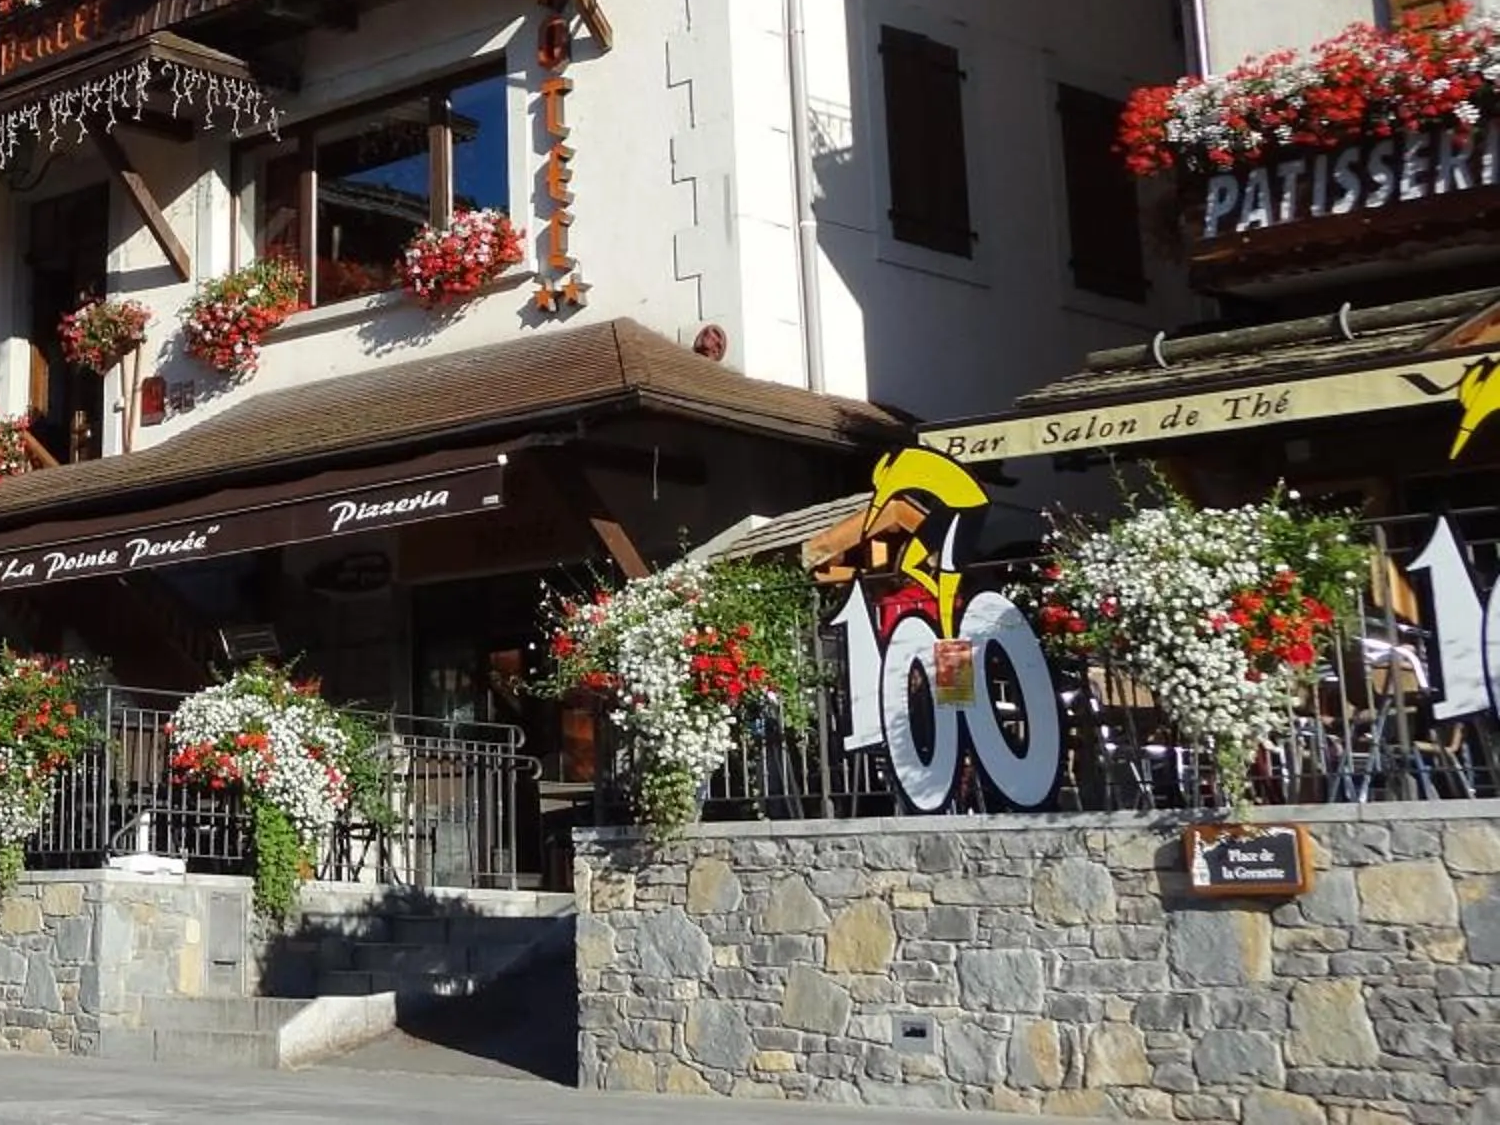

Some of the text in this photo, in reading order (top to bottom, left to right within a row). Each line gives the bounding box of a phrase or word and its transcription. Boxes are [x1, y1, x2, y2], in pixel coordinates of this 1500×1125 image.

[946, 388, 1291, 458] Bar Salon de Thé
[328, 490, 449, 531] Pizzeria
[43, 550, 117, 579] Pointe
[829, 578, 1060, 812] 100
[1228, 848, 1275, 862] Place de
